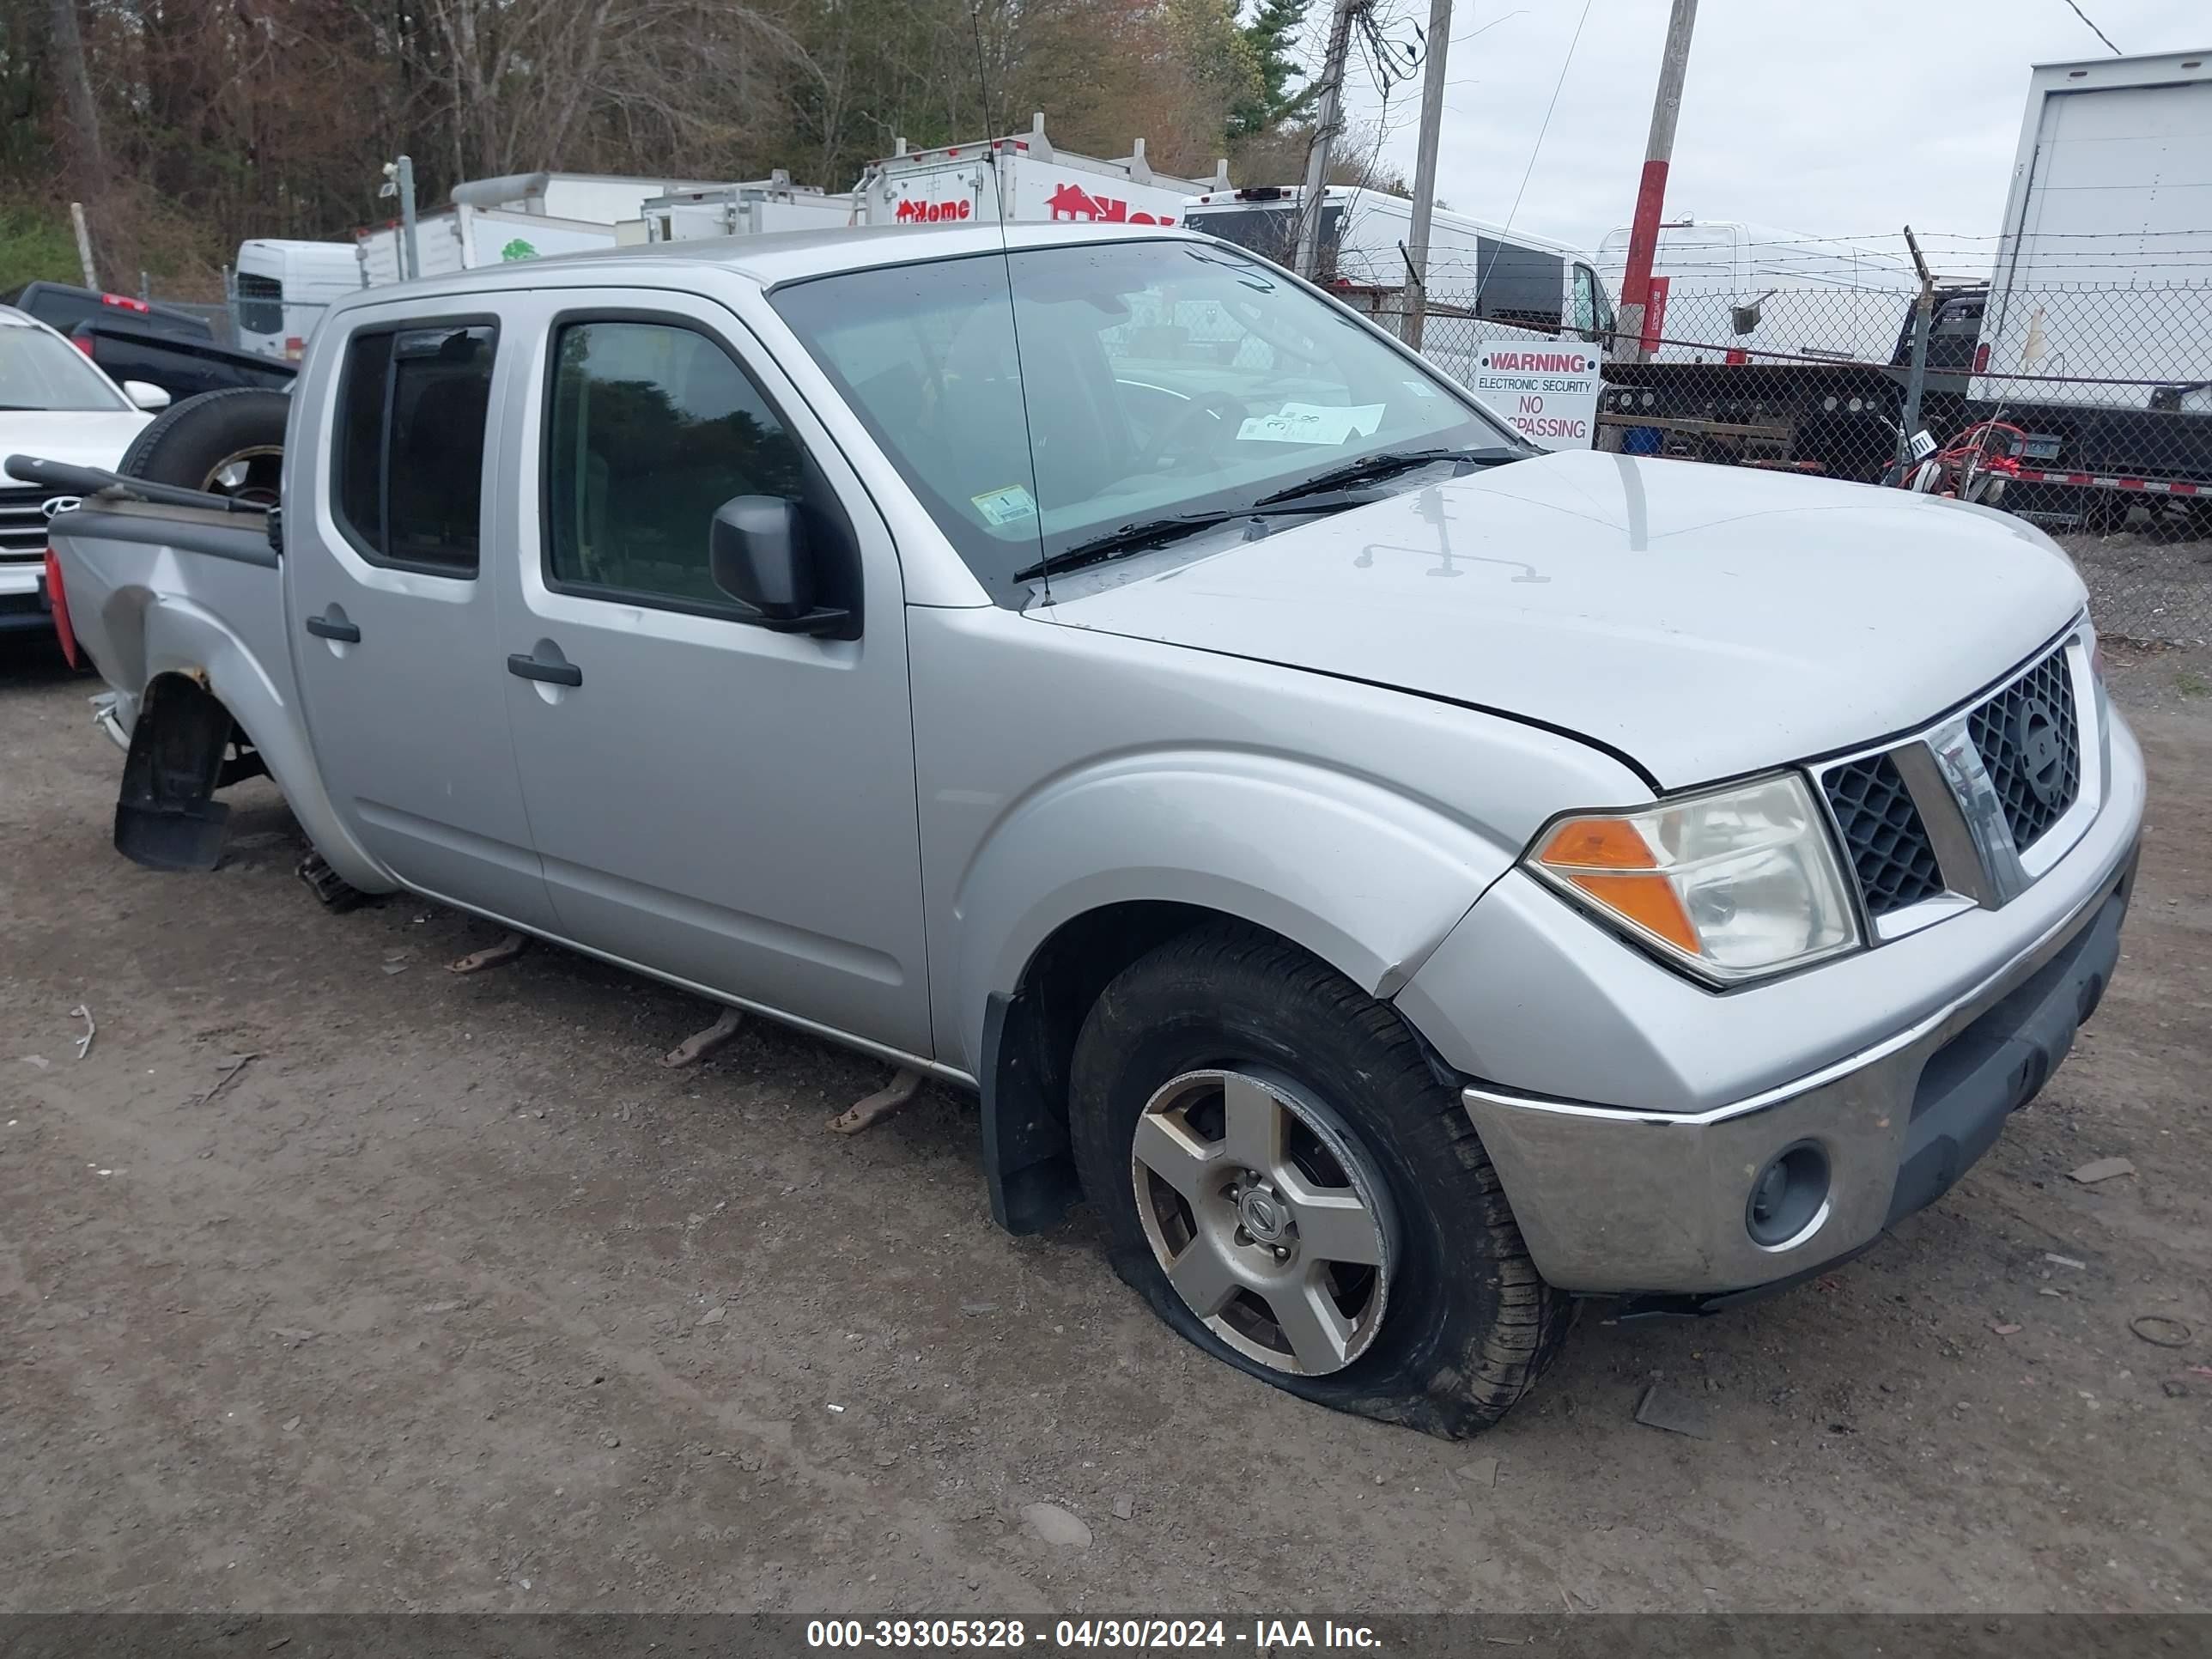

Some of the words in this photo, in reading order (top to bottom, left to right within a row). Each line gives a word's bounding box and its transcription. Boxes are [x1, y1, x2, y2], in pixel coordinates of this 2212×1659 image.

[1490, 352, 1586, 373] WARNING
[1479, 377, 1539, 390] ELECTRONIC
[1542, 380, 1592, 392] SECURITY
[1518, 395, 1544, 414] NO
